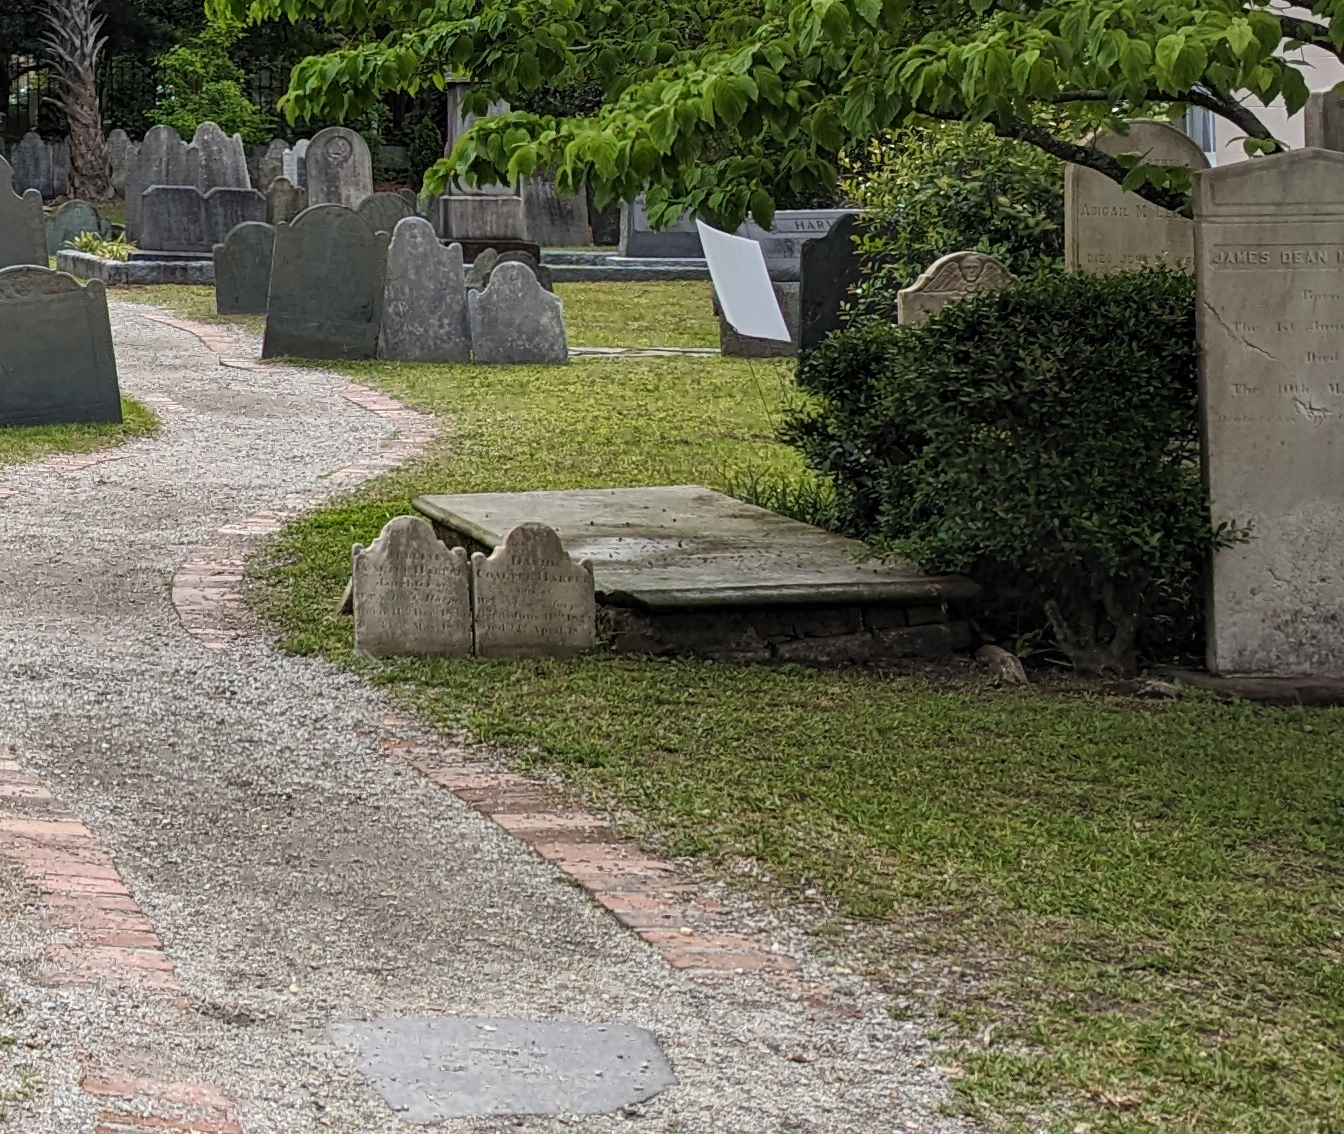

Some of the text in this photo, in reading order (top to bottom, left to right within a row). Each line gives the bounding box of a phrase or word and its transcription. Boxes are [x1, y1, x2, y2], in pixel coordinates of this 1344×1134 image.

[794, 219, 833, 231] HARV
[1214, 250, 1272, 265] JAMES
[1281, 250, 1329, 265] DEAN
